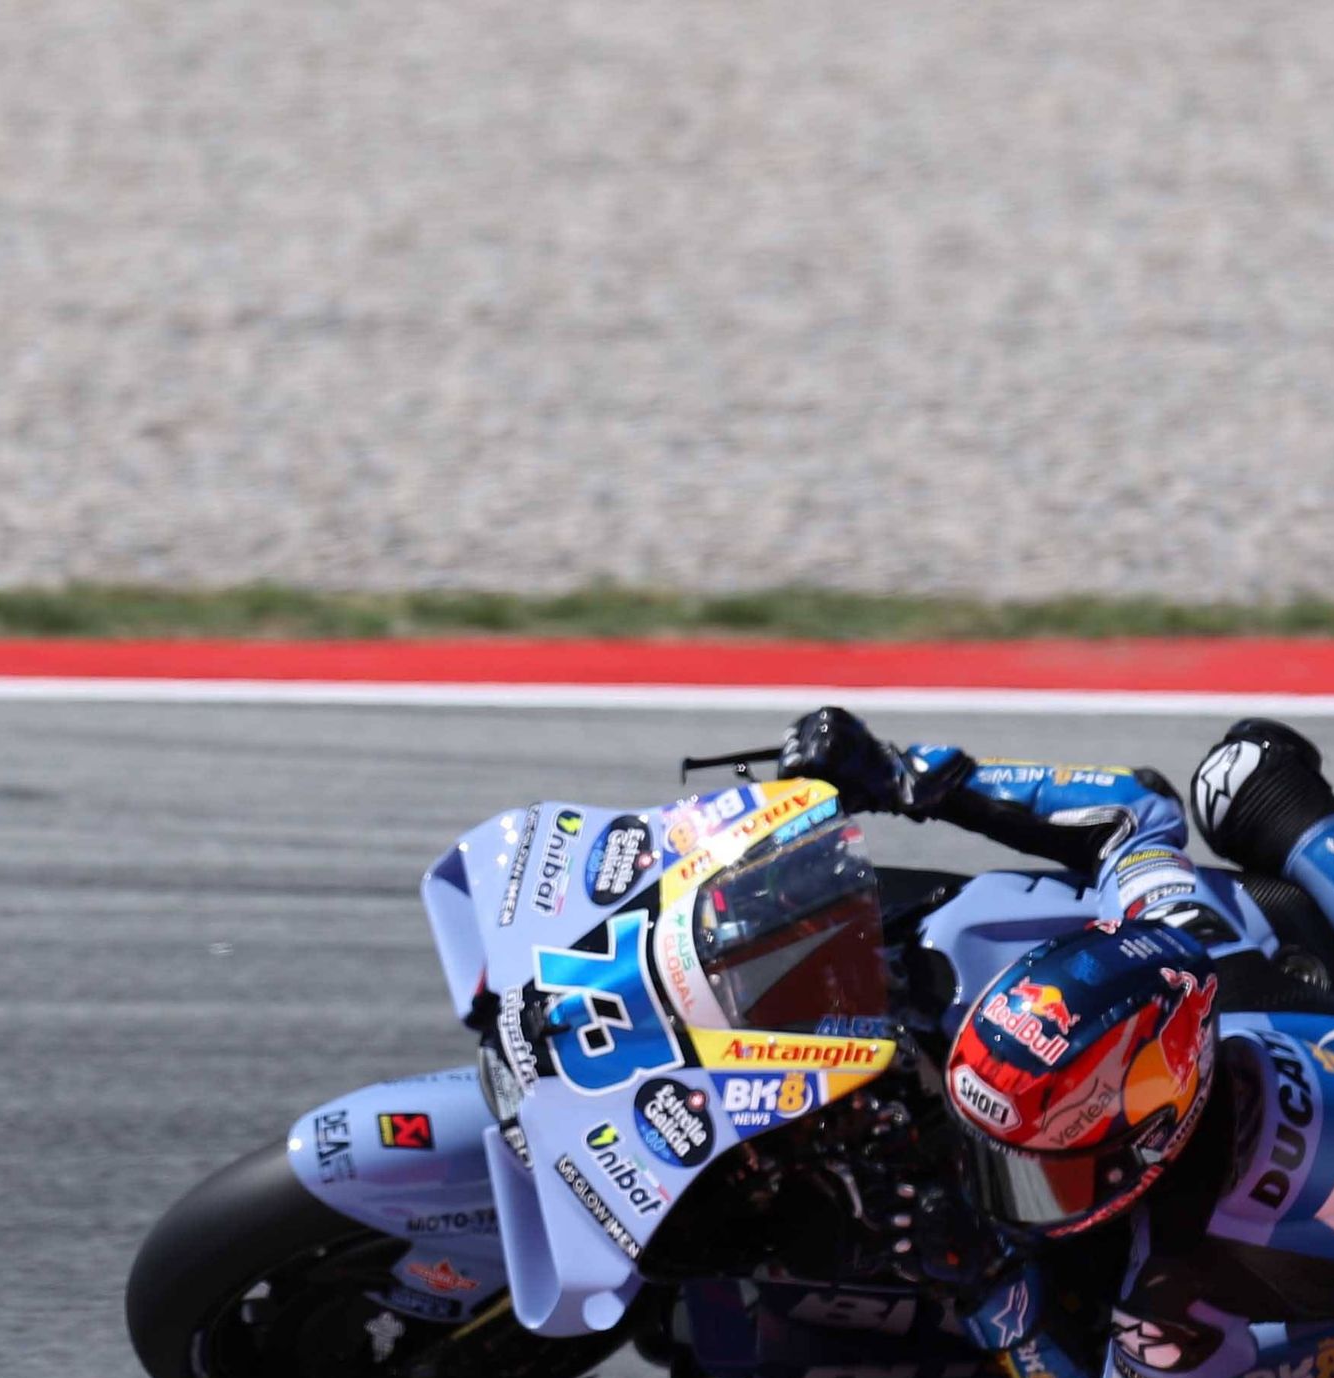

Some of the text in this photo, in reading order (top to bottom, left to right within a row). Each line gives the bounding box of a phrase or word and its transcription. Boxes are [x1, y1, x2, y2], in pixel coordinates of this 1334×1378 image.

[722, 1039, 879, 1067] Antangin
[654, 1083, 707, 1148] Estrella
[723, 1073, 810, 1115] BK8
[733, 1112, 771, 1126] NEWS
[959, 1076, 1010, 1125] SHOEI
[1250, 1029, 1315, 1210] DUCAT
[644, 1097, 691, 1158] Galicia
[586, 1122, 664, 1216] Unibat
